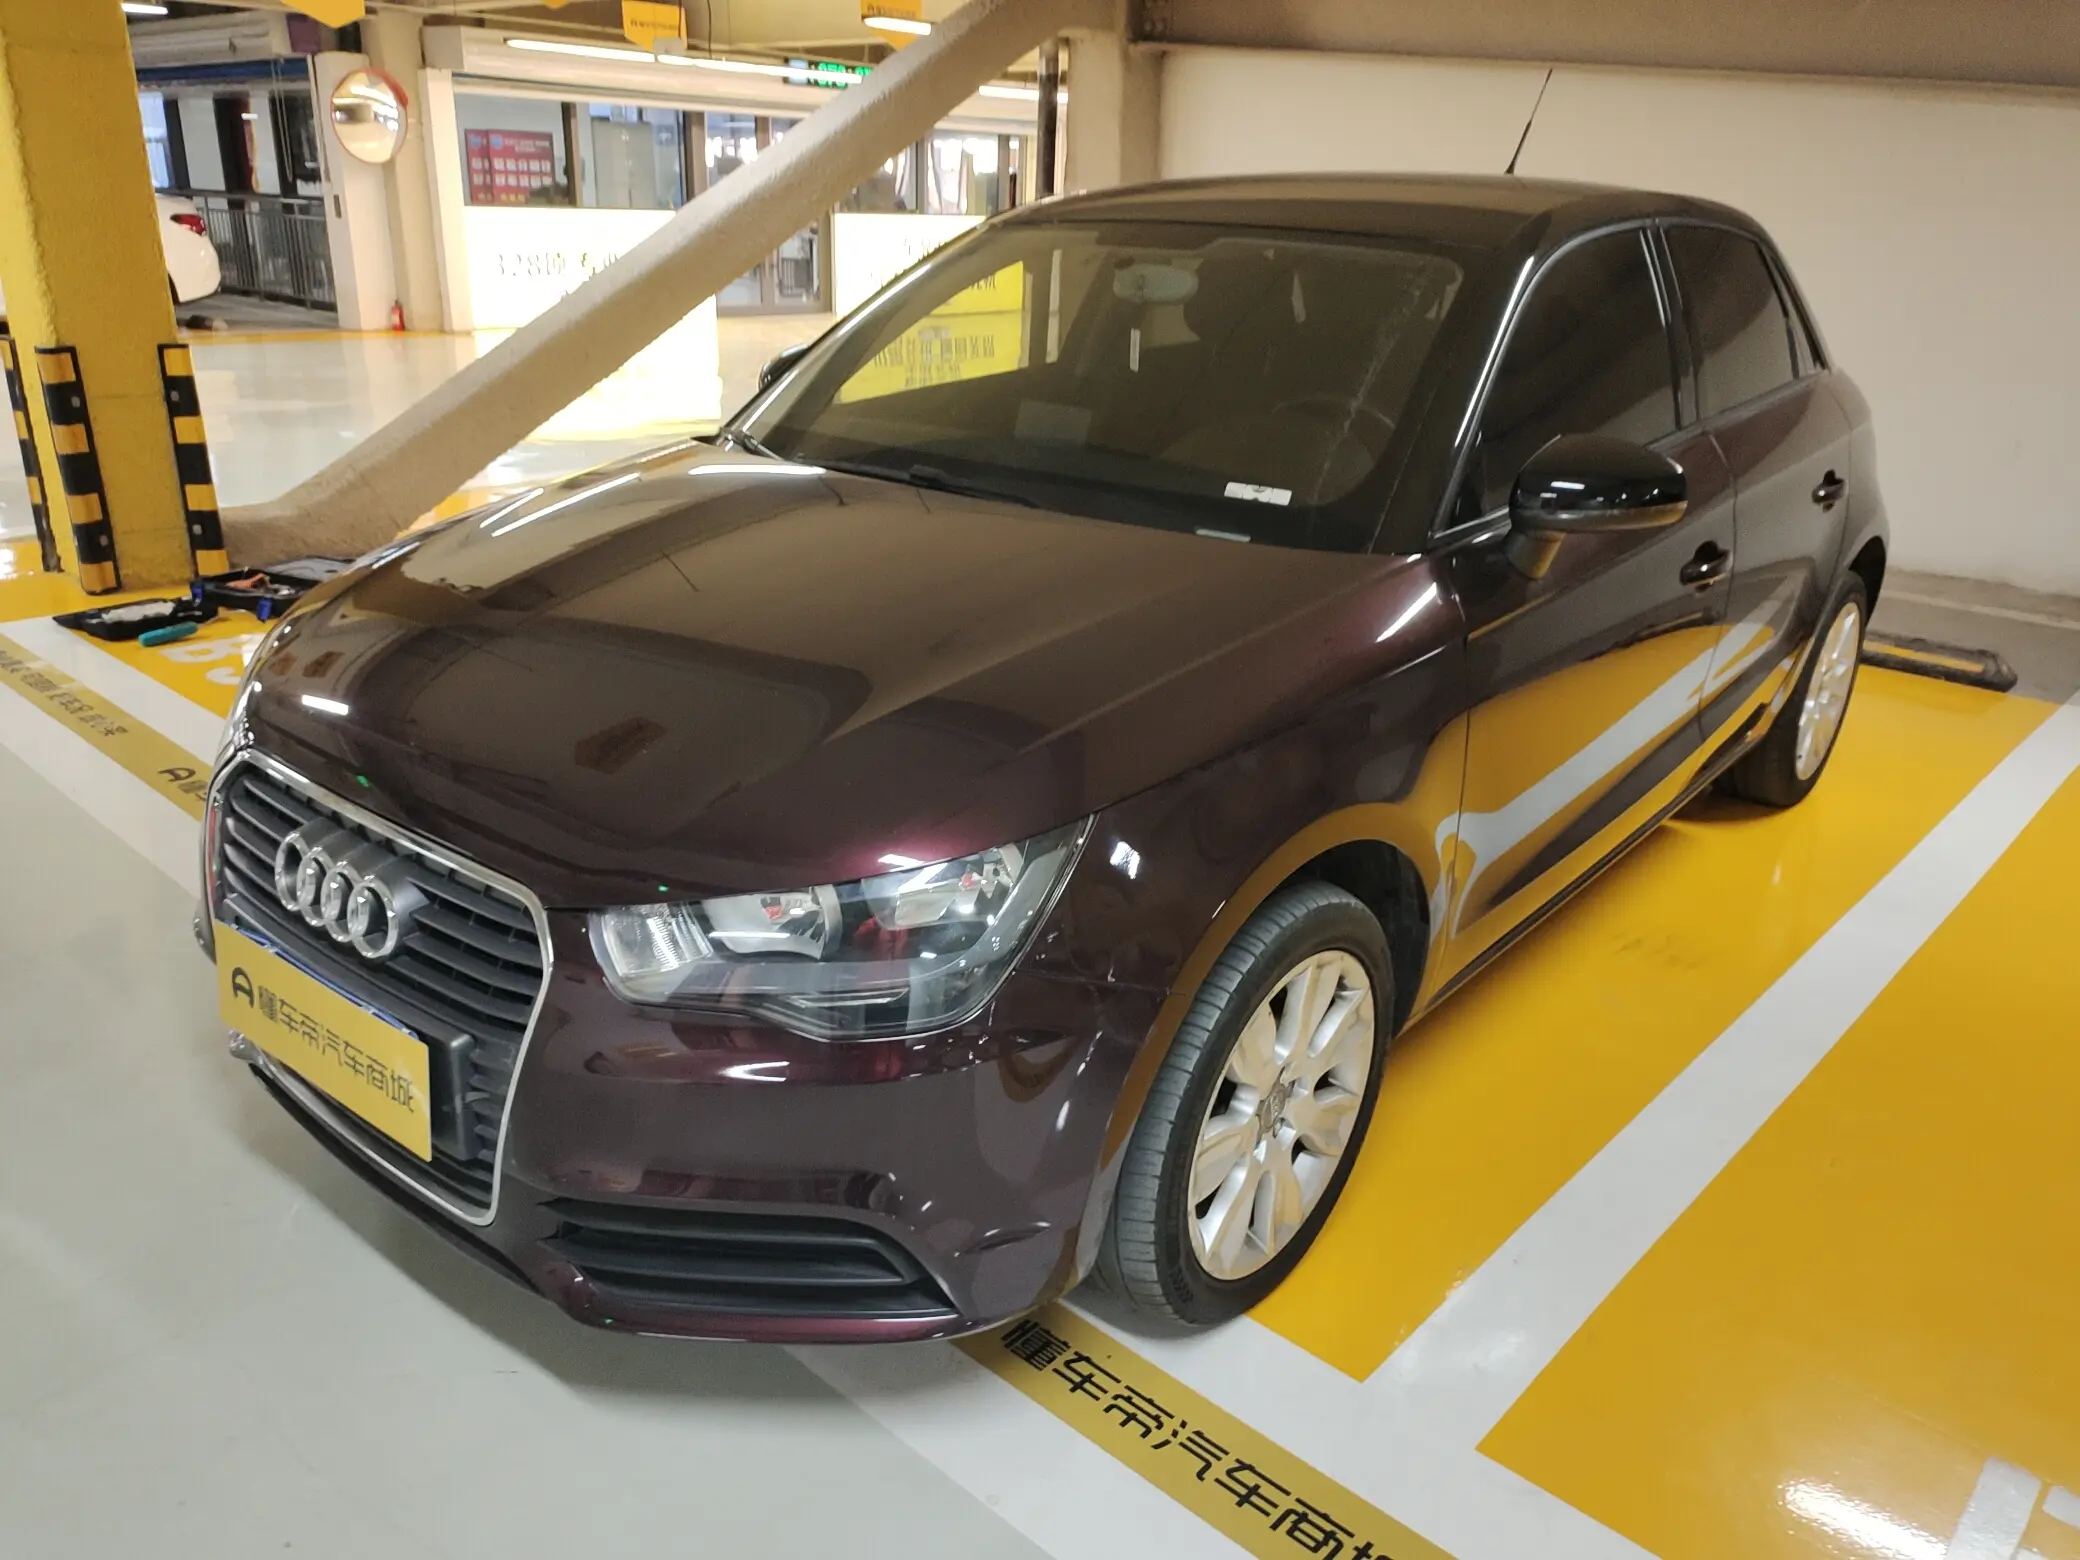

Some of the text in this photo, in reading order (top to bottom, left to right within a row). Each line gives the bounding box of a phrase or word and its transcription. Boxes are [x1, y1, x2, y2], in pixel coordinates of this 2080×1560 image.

[258, 984, 415, 1114] 懂车帝汽车商城
[1000, 1318, 1396, 1560] 懂车帝汽车商
